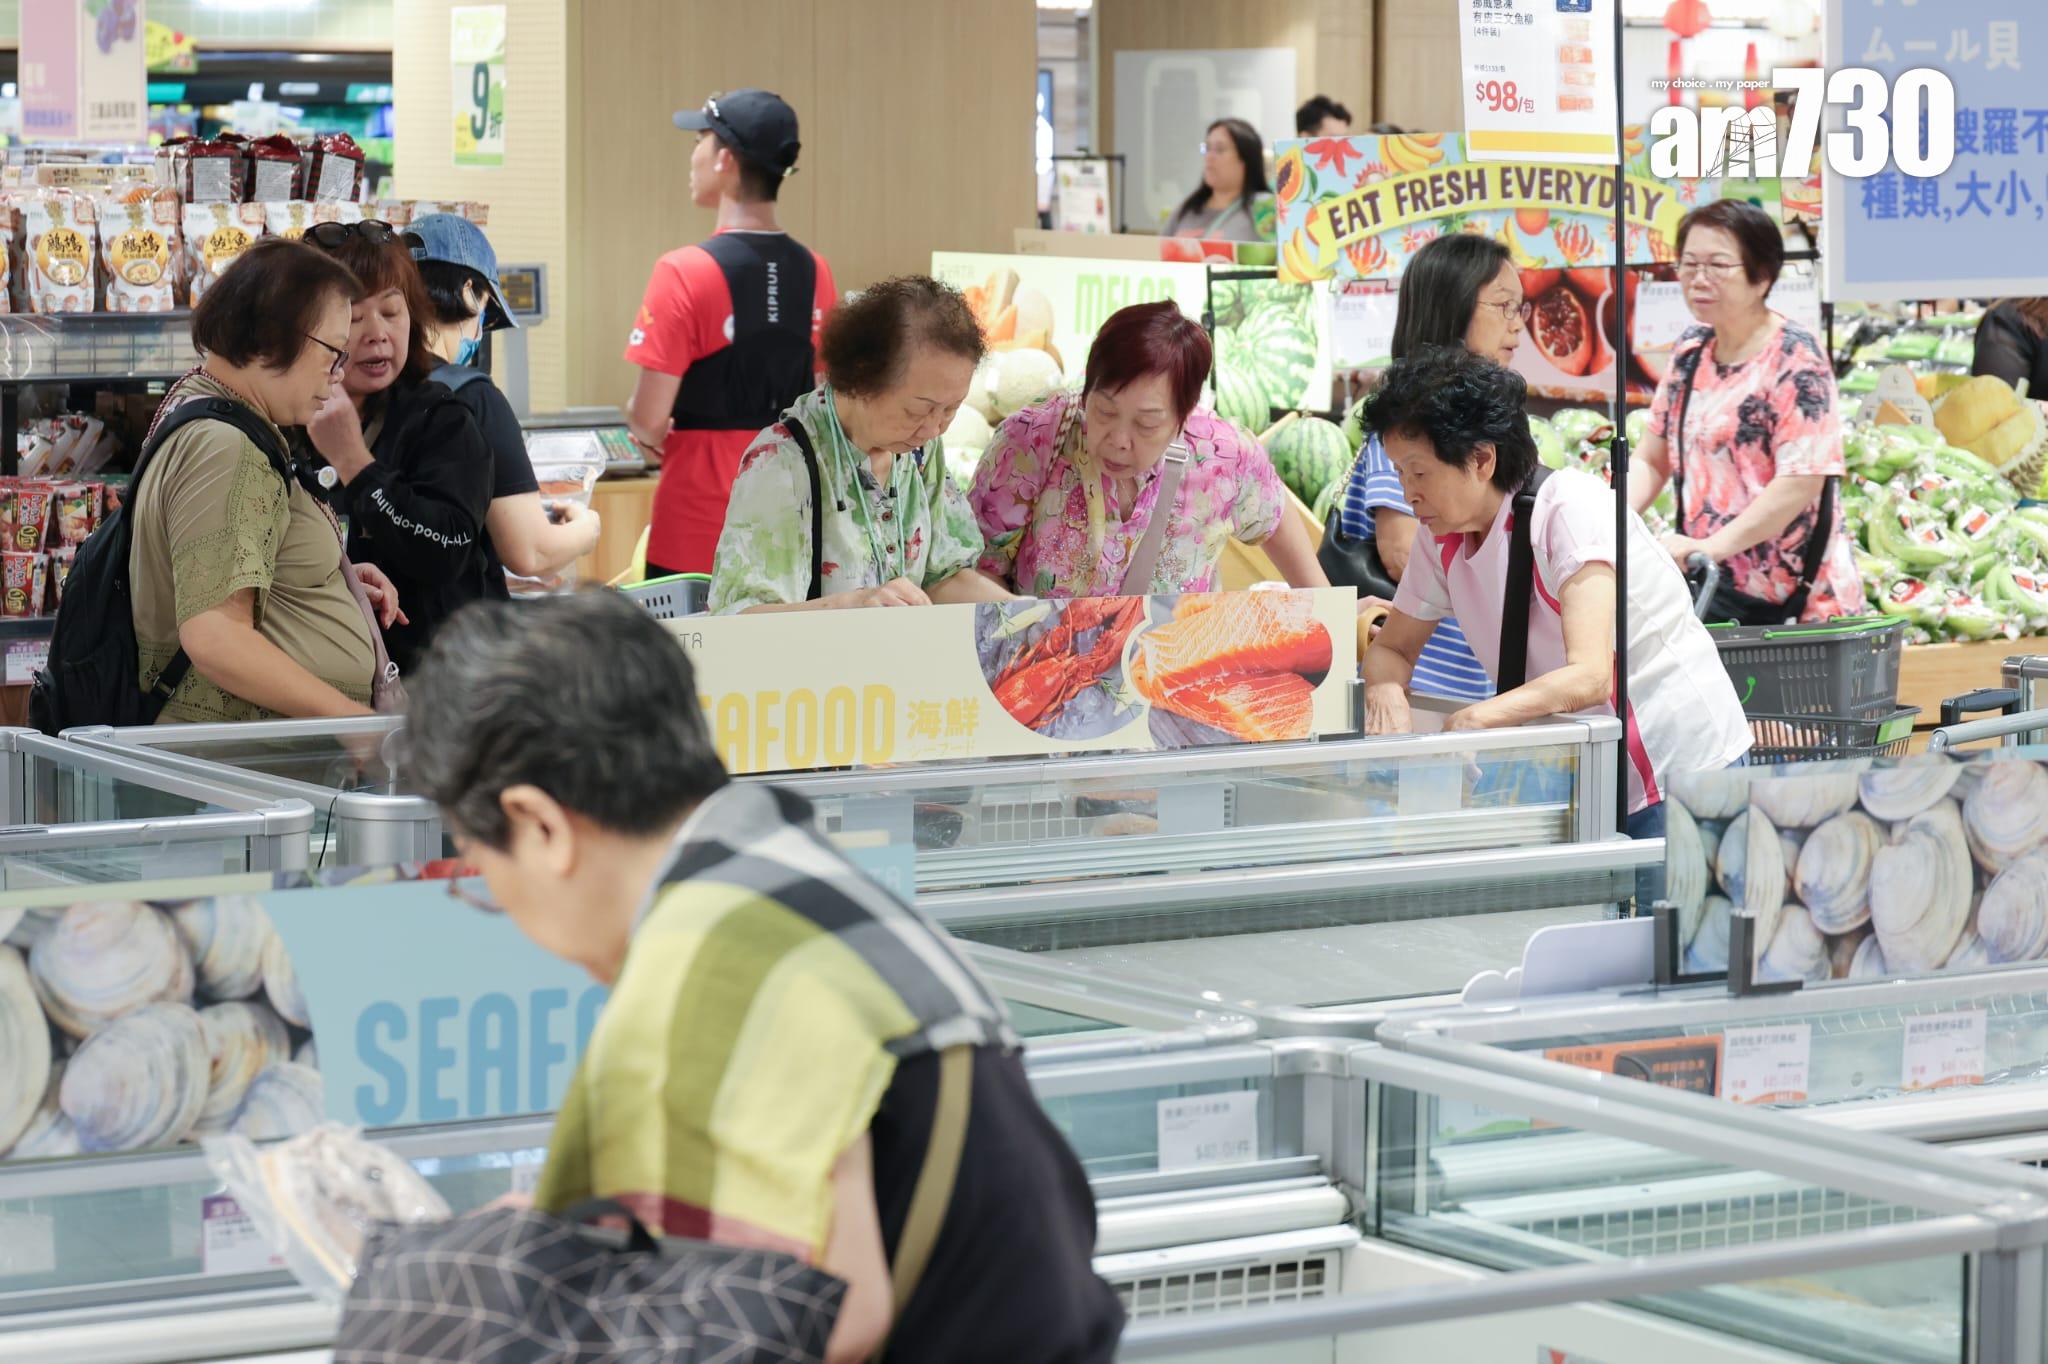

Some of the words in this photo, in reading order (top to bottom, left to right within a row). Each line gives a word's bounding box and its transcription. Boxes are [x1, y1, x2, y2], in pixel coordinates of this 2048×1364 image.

[1861, 20, 2022, 71] ムール貝
[1328, 188, 1383, 240] EAT
[1393, 168, 1488, 217] FRESH
[1500, 166, 1665, 222] EVERYDAY
[1861, 169, 2048, 223] 種類,大小,
[766, 261, 779, 323] KIPRUN
[700, 683, 896, 773] AFOOD
[906, 696, 979, 740] 海鮮
